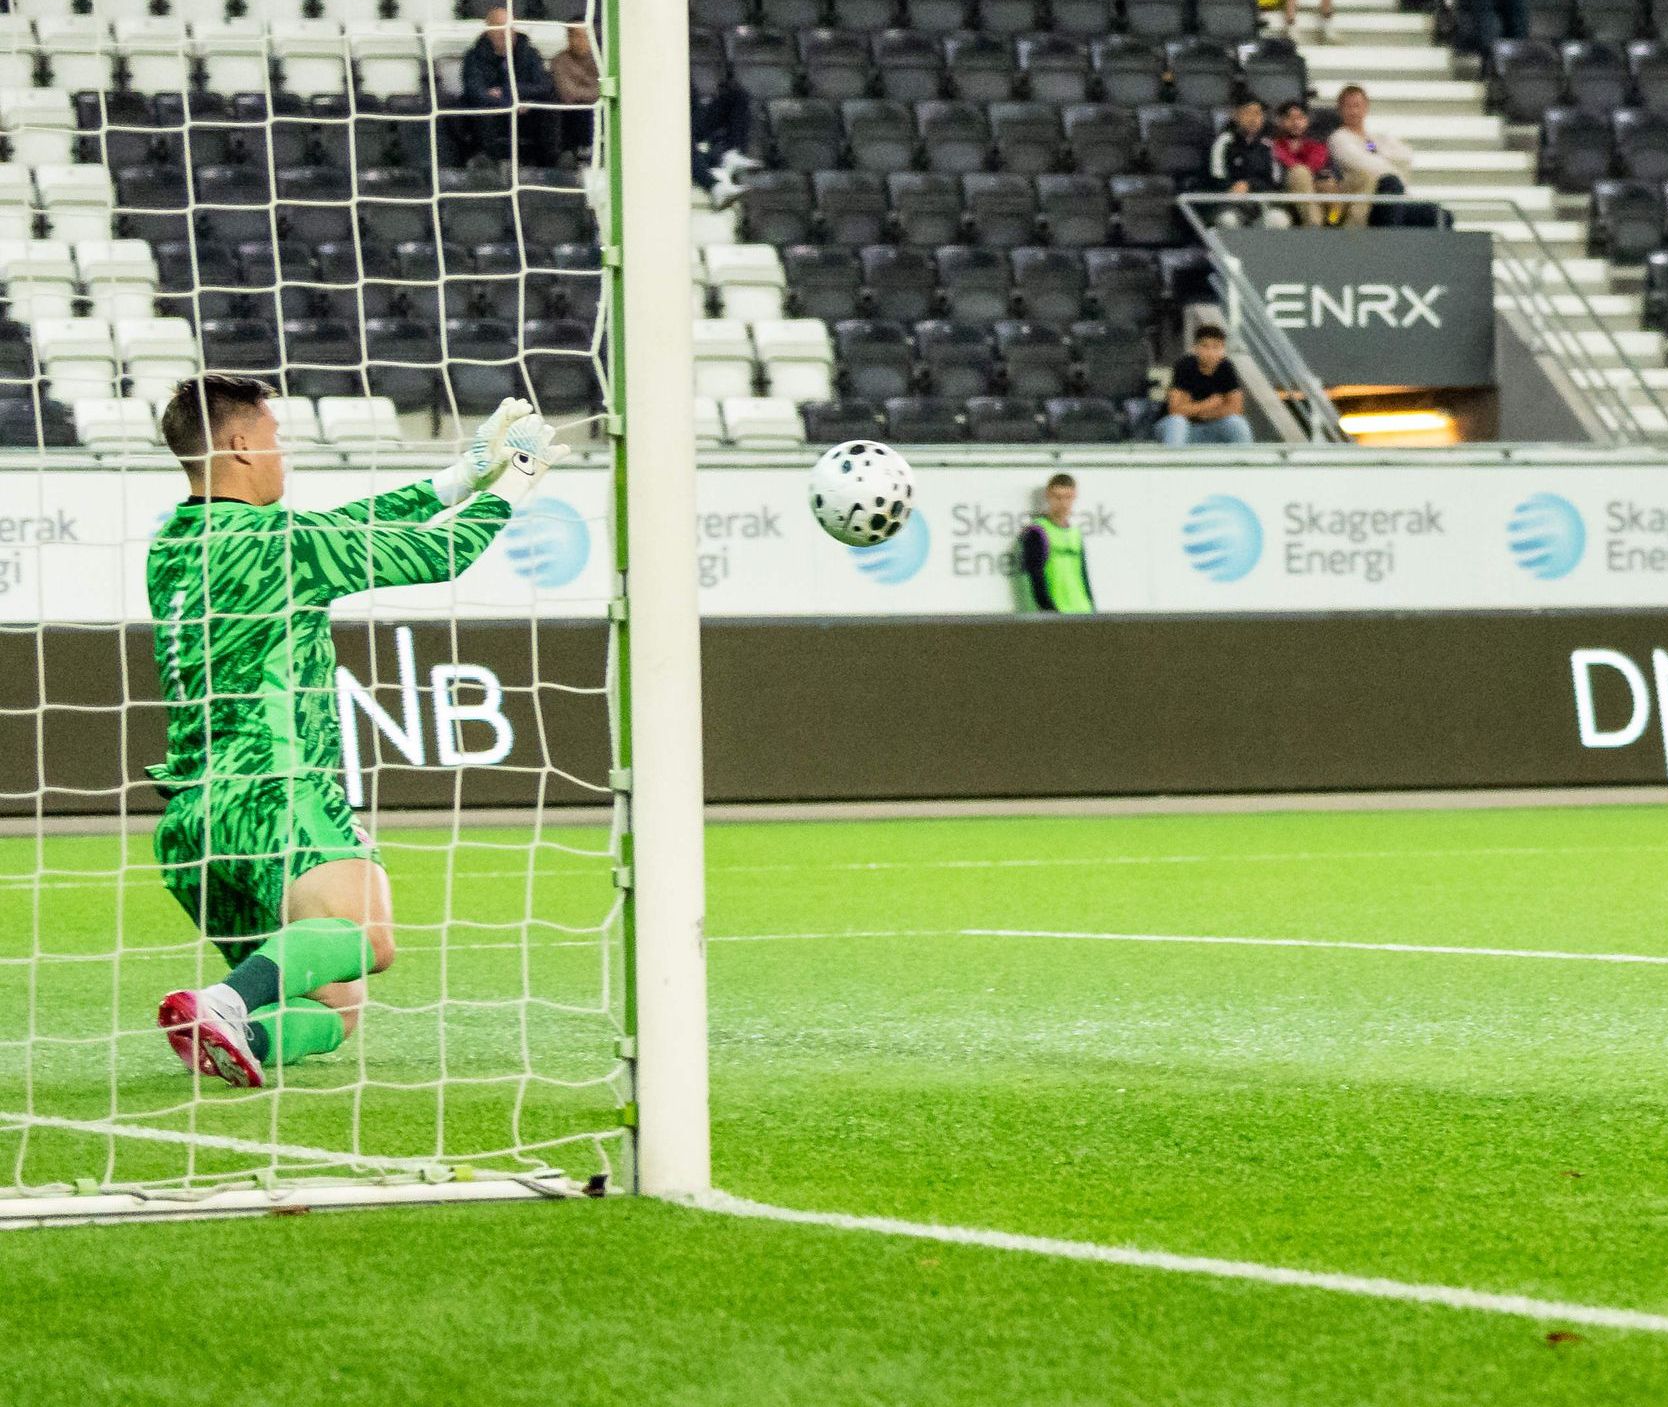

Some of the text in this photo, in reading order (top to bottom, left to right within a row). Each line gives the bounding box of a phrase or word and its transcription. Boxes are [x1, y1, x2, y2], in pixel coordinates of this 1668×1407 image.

[1265, 284, 1442, 329] ENRX
[1283, 502, 1444, 543] Skagerak
[1284, 543, 1396, 581] Energi
[333, 626, 514, 808] NB
